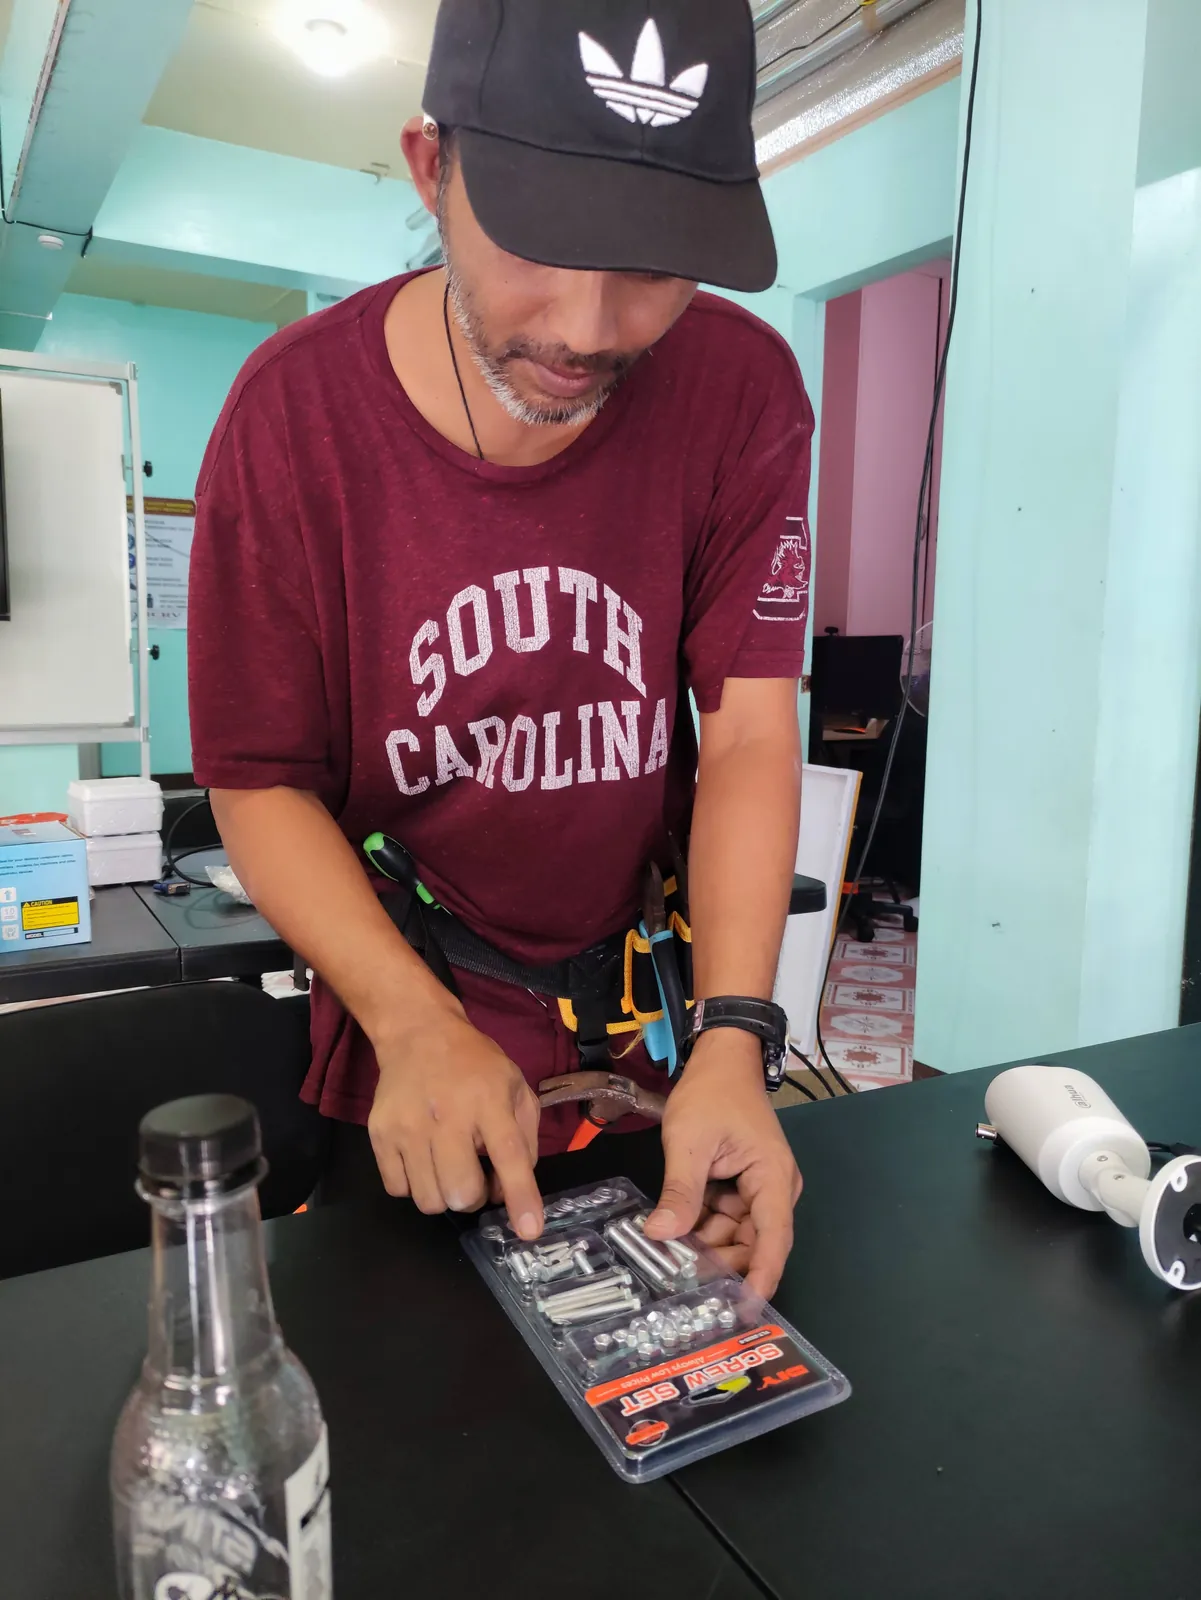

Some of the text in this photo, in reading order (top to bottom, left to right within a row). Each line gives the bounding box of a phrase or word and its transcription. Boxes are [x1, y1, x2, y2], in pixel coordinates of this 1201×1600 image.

[409, 566, 647, 717] SOUTH
[385, 698, 669, 796] CAROLINA
[620, 1343, 784, 1417] SCREW SET
[621, 1357, 705, 1388] Always Low Prices
